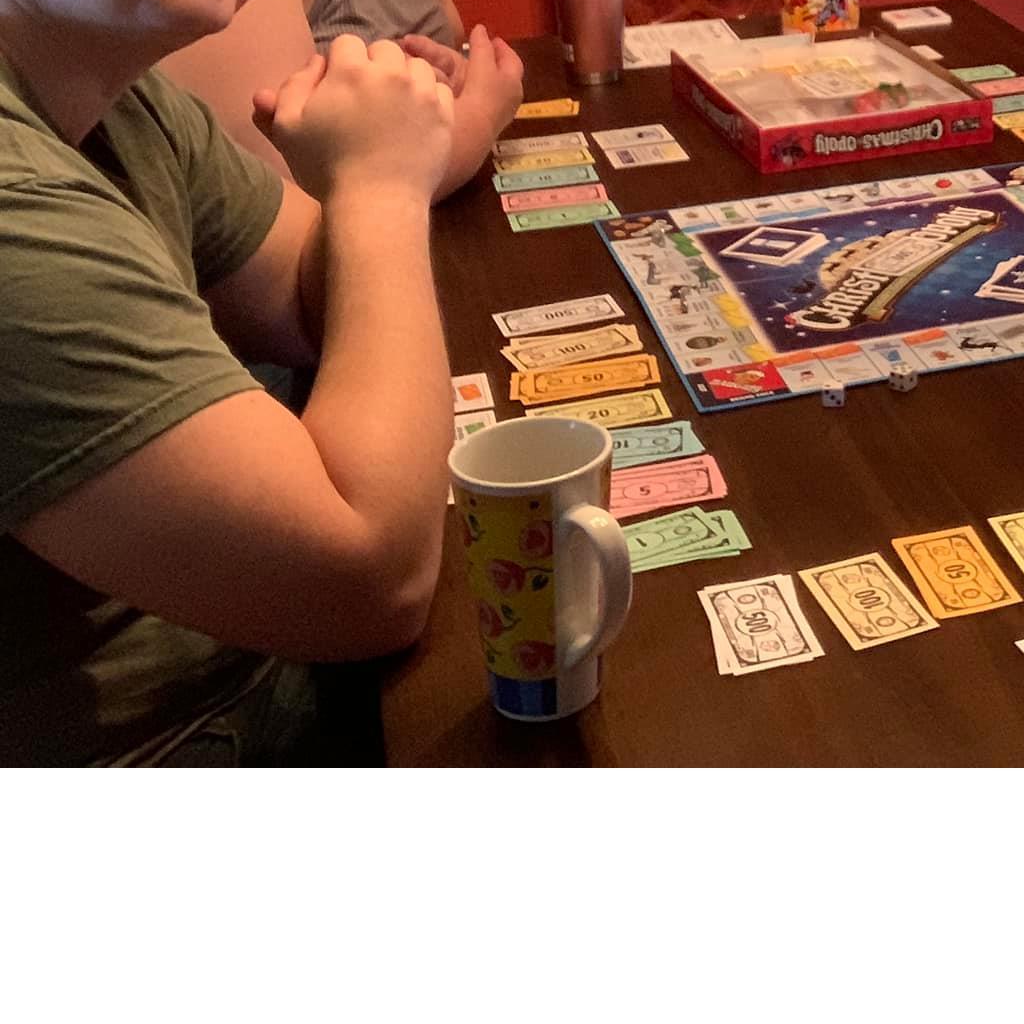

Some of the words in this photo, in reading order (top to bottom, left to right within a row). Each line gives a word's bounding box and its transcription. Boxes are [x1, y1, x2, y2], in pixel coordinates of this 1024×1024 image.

[544, 308, 574, 321] 500
[558, 342, 587, 355] 100
[581, 373, 604, 383] 50
[587, 408, 610, 420] 20
[639, 486, 651, 496] 5
[635, 536, 648, 548] 1
[943, 562, 972, 580] 50
[853, 588, 883, 611] 100
[741, 611, 772, 634] 500
